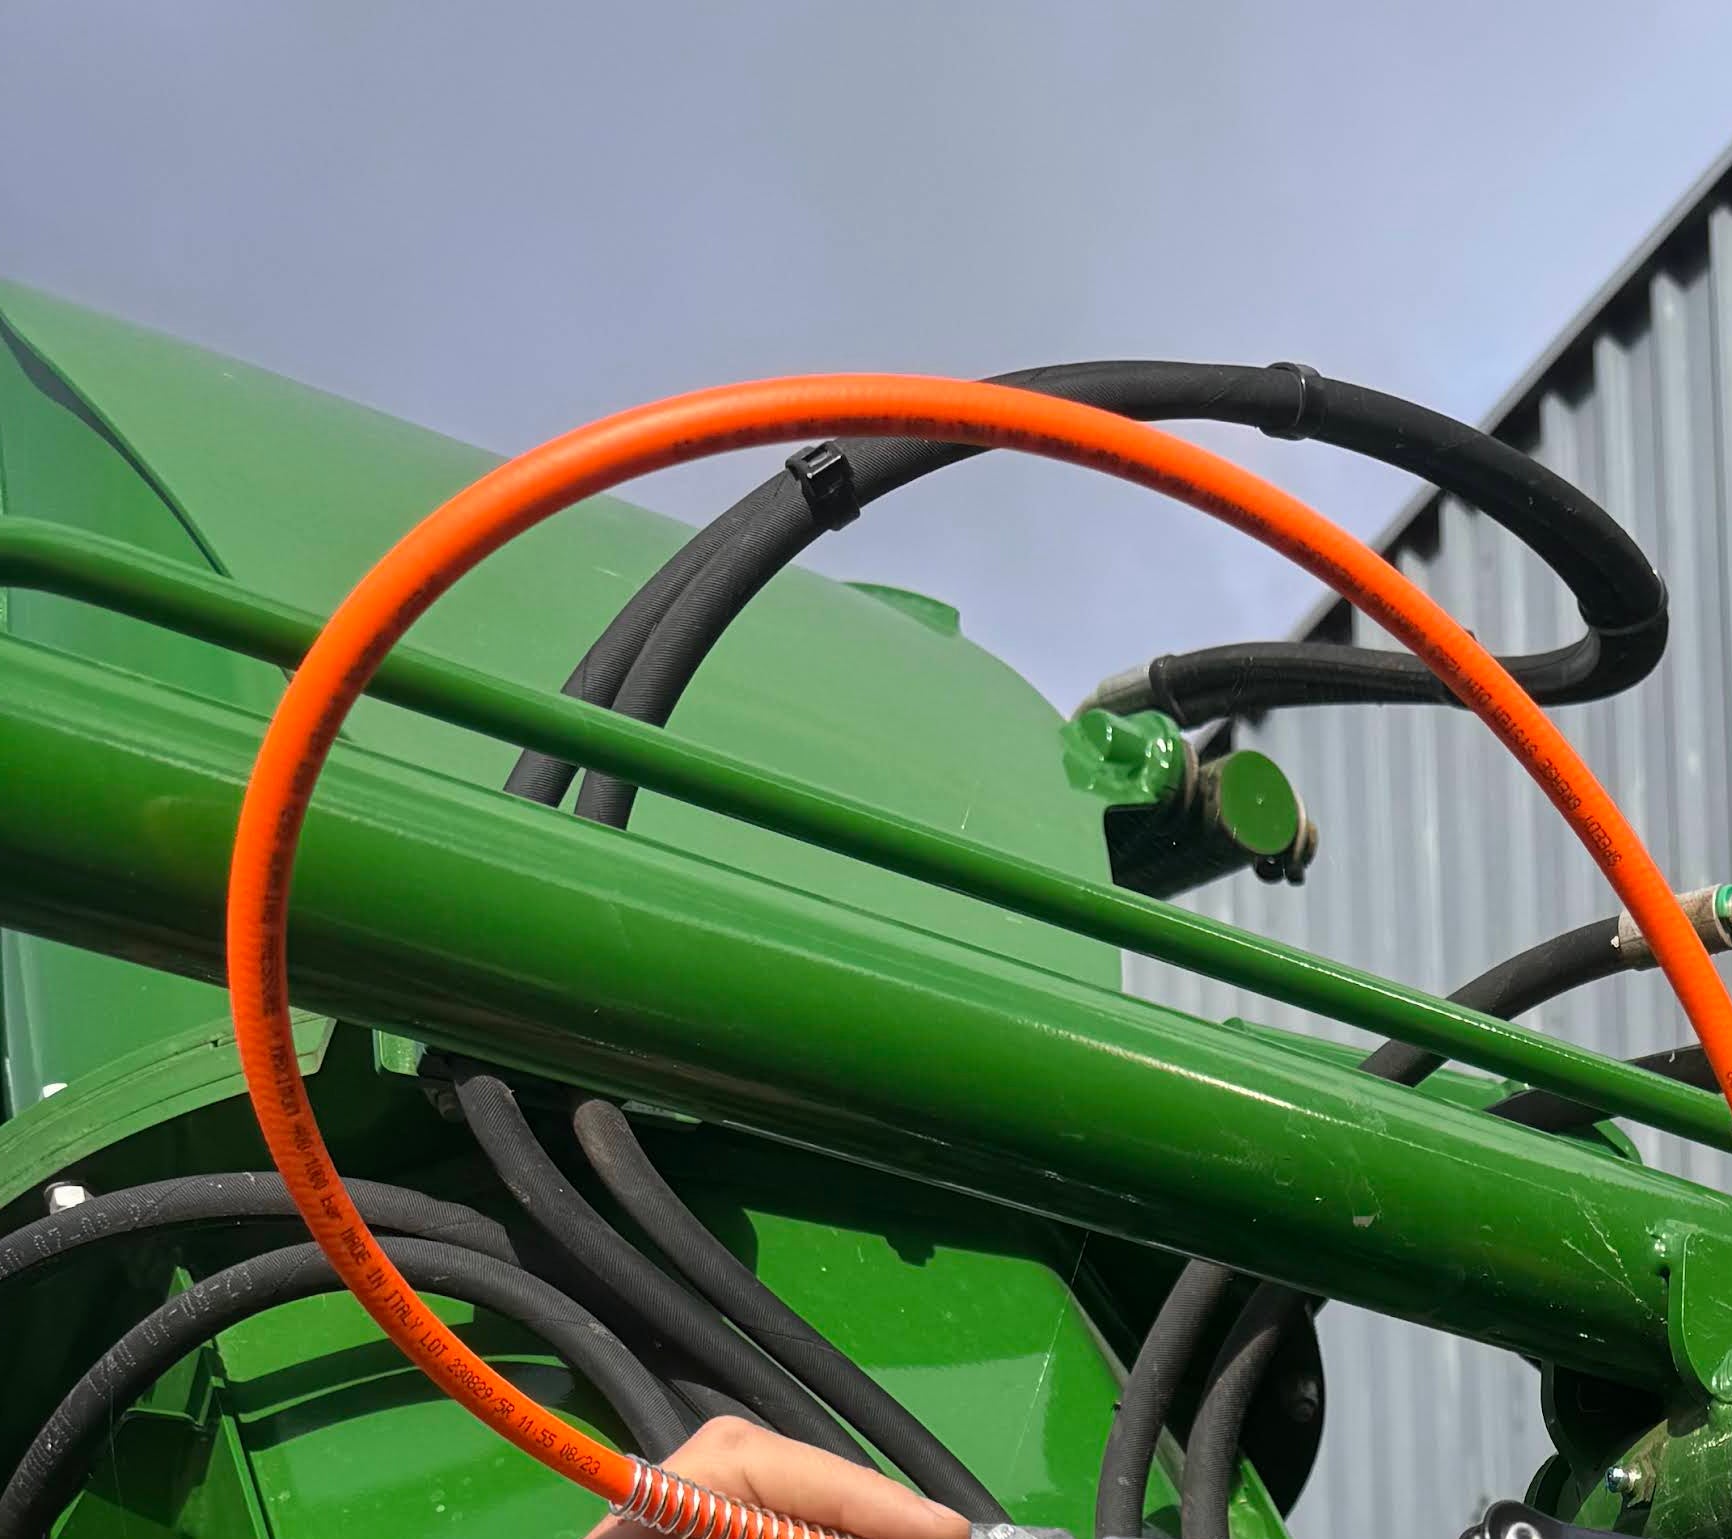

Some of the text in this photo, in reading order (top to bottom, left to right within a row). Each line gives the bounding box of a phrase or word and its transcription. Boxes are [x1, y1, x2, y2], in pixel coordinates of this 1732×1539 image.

[1536, 758, 1582, 812] GREASE
[319, 1192, 346, 1224] bar
[338, 1223, 373, 1266] MADE
[365, 1265, 390, 1290] IN
[382, 1287, 424, 1334] ITALY
[418, 1328, 449, 1359] LOT
[445, 1355, 517, 1420] 230829/5R
[514, 1412, 557, 1450] 11:55
[558, 1441, 602, 1478] 08/23
